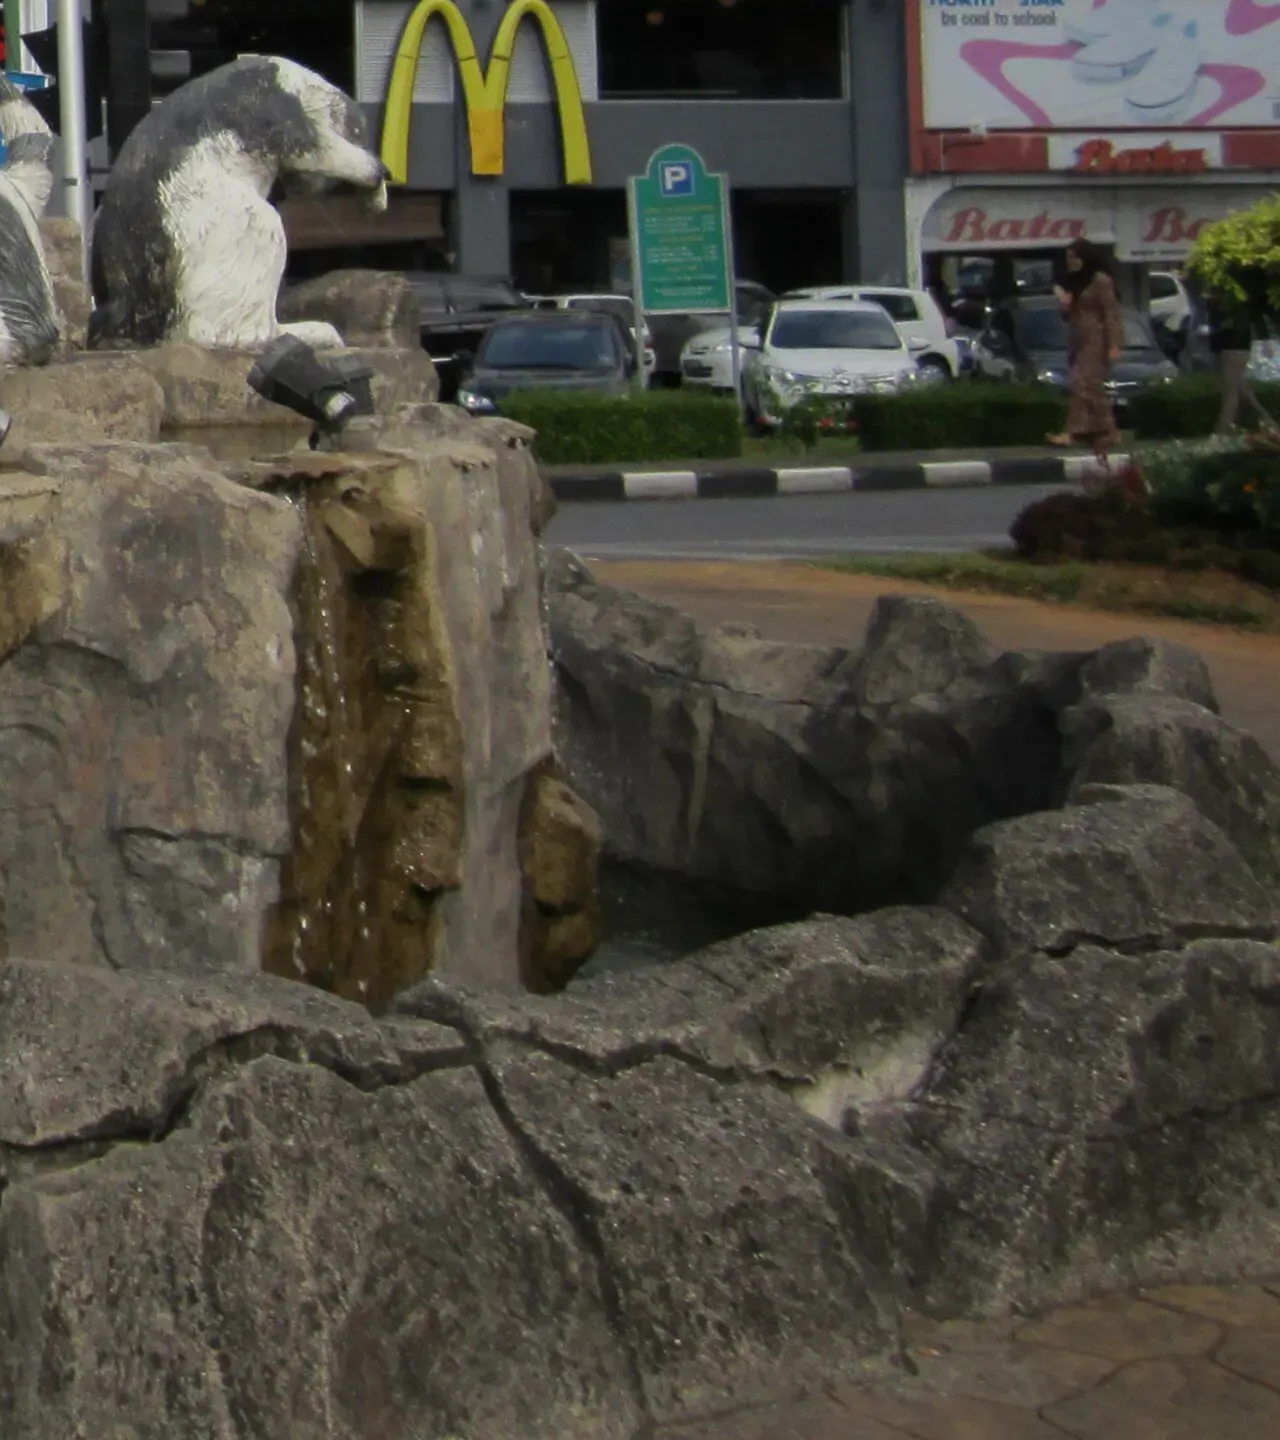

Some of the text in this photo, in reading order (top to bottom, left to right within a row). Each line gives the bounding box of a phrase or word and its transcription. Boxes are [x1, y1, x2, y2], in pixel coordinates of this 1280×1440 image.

[994, 13, 1009, 26] to
[1012, 10, 1056, 26] school
[1073, 139, 1207, 173] Bata
[664, 166, 686, 191] P
[945, 206, 1087, 242] Bata
